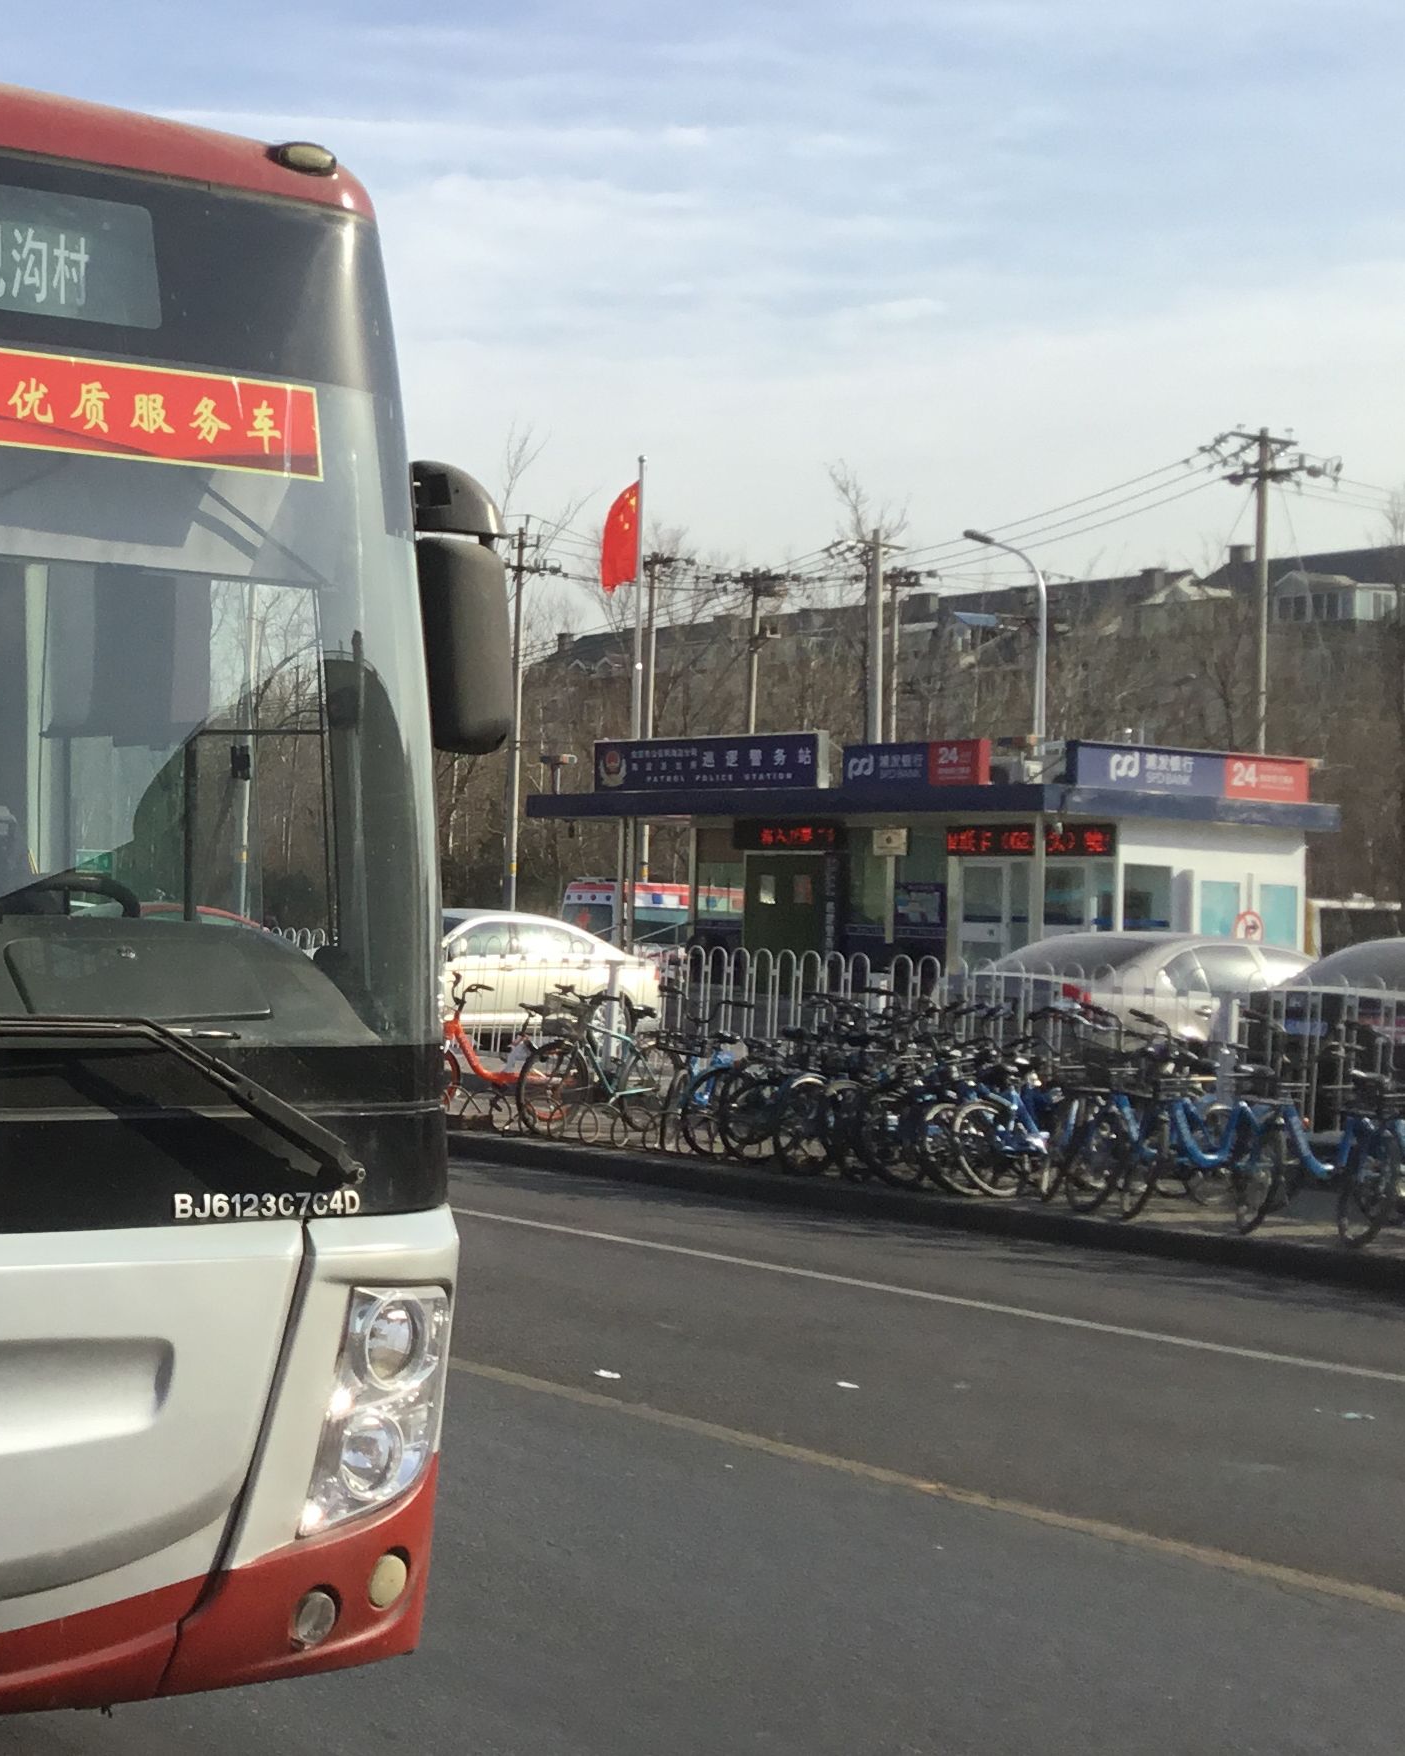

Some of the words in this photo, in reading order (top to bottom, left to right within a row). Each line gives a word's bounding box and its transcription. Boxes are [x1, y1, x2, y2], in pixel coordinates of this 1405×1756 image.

[7, 376, 283, 454] 优质服务车
[938, 746, 959, 764] 24
[1231, 760, 1257, 788] 24
[173, 1192, 361, 1219] BJ6123C7C4D
